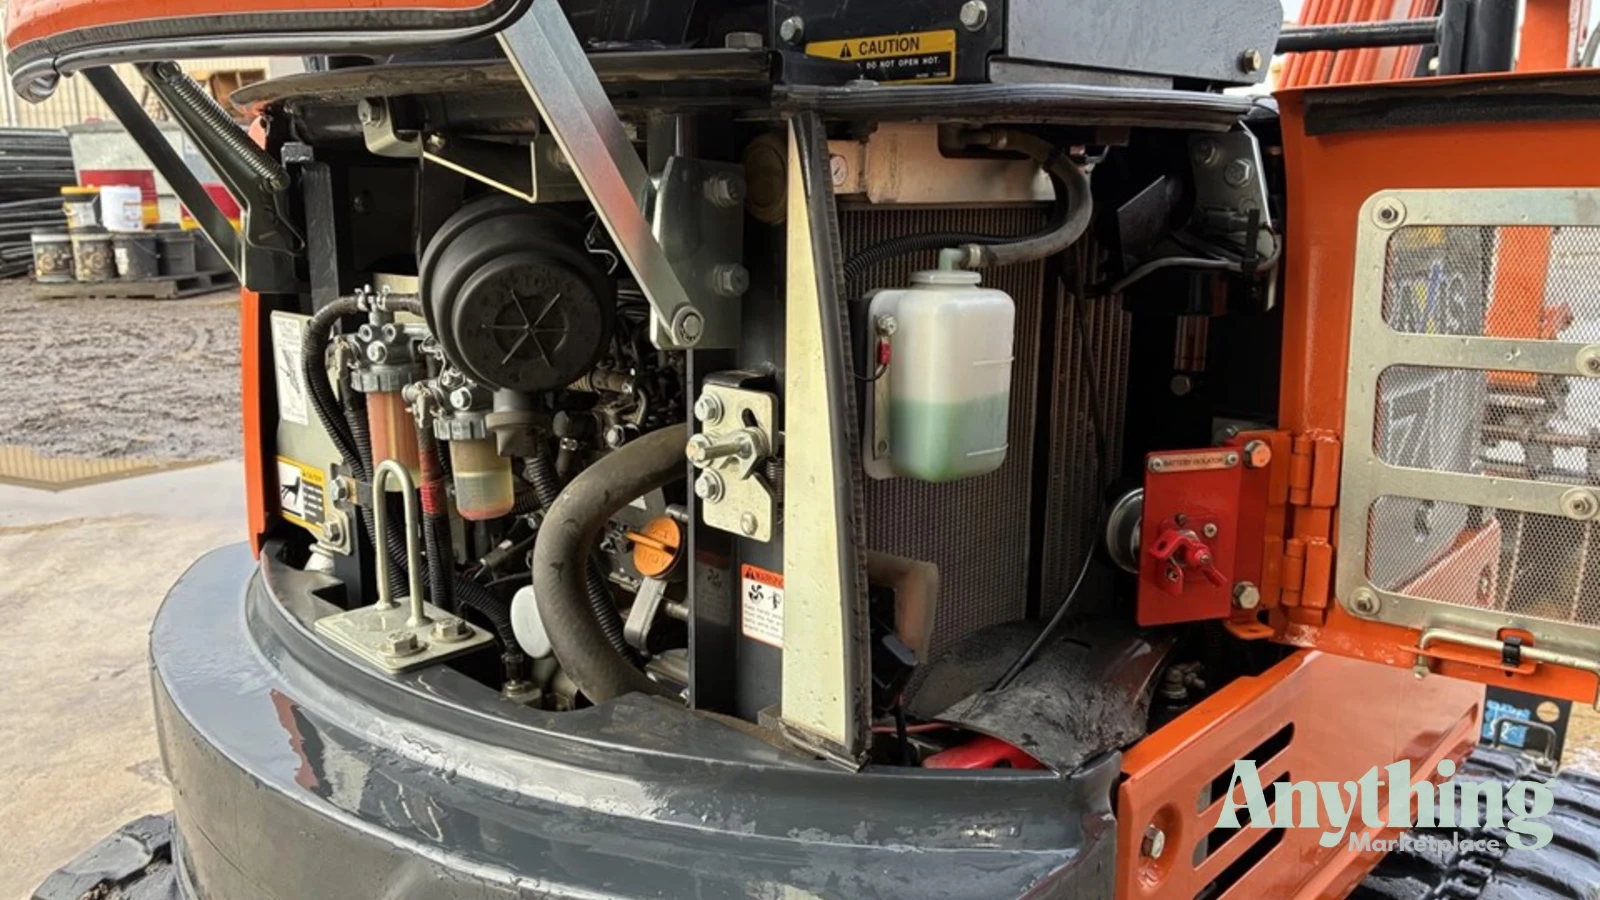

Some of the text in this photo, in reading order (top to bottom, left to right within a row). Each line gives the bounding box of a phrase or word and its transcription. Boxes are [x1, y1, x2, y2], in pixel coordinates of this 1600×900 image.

[859, 37, 919, 56] CAUTION
[866, 61, 877, 70] DO
[880, 59, 895, 68] NOT
[898, 57, 919, 67] OPEN
[1193, 457, 1224, 466] ISOLATOR
